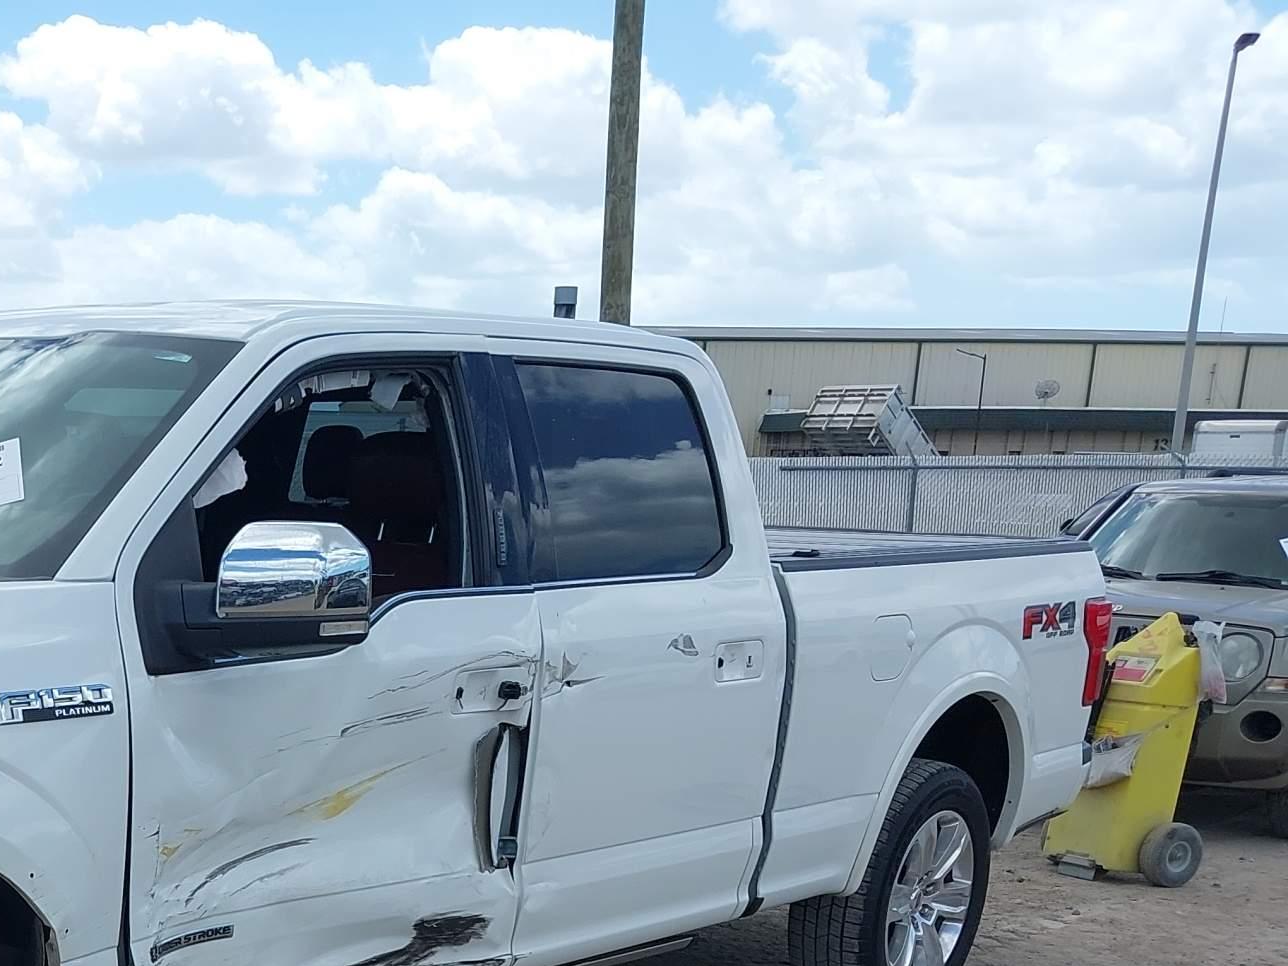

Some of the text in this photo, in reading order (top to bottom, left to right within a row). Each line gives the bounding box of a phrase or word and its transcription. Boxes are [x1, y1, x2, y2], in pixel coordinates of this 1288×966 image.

[1022, 601, 1076, 640] FX4
[55, 704, 111, 718] PLATINUM
[183, 926, 231, 944] STROKE
